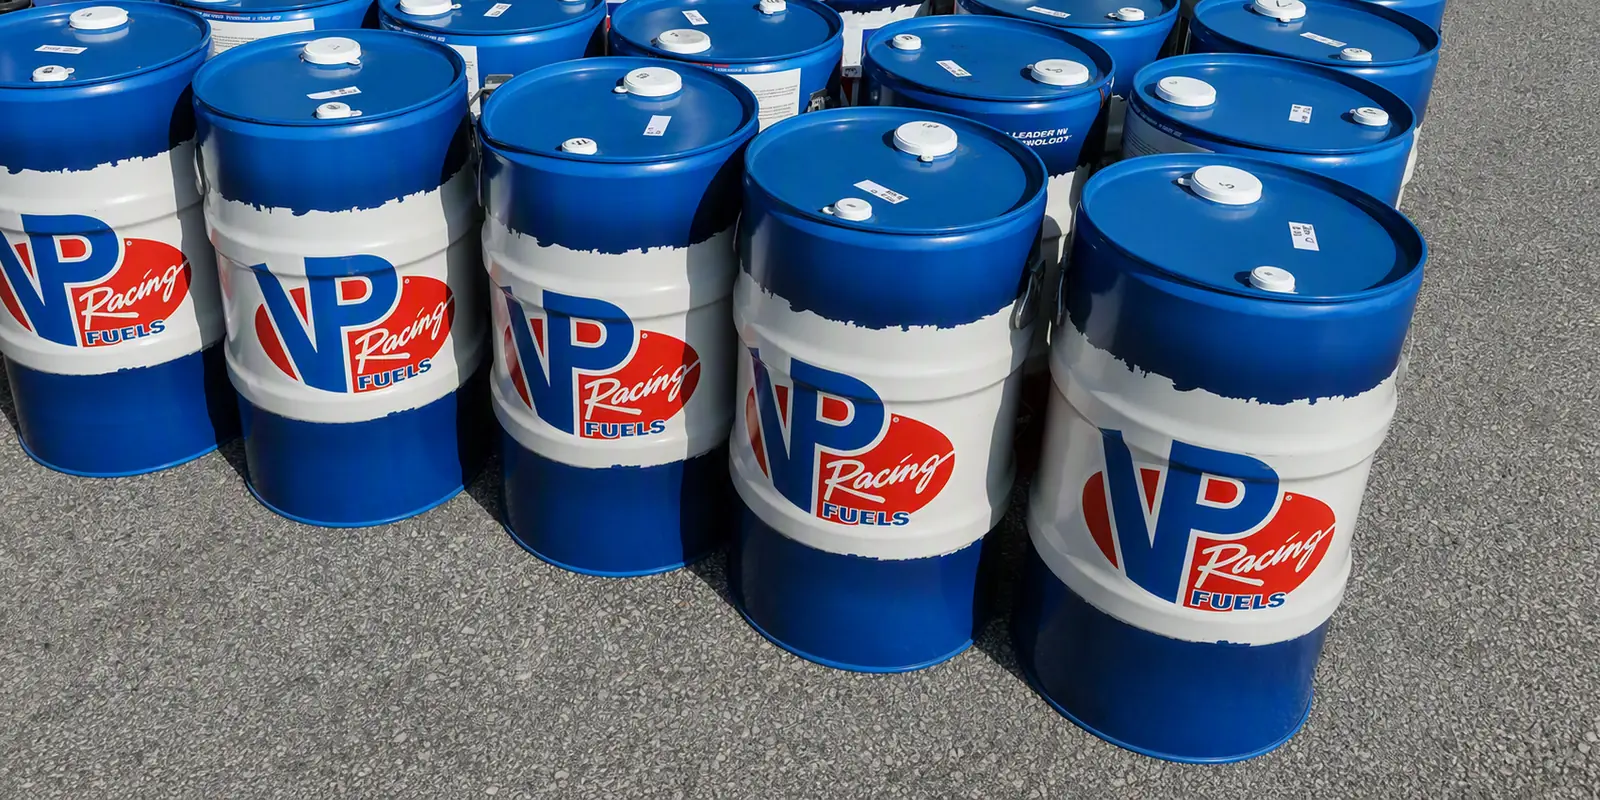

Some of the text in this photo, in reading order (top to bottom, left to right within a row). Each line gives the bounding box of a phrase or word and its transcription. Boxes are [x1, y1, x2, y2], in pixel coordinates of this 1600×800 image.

[1012, 129, 1056, 139] LEADER
[0, 213, 119, 347] VP
[79, 258, 190, 331] Racing
[85, 320, 166, 346] FUELS
[249, 253, 399, 394] VP
[354, 294, 454, 375] Racing
[357, 357, 433, 390] FUELS
[499, 284, 635, 436] VP
[583, 358, 701, 421] Racing
[583, 419, 667, 438] FUELS
[747, 346, 886, 515] VP
[823, 449, 955, 505] Racing
[822, 501, 911, 527] FUELS
[1097, 426, 1280, 604] VP
[1194, 521, 1336, 589] Racing
[1190, 590, 1287, 612] FUELS
